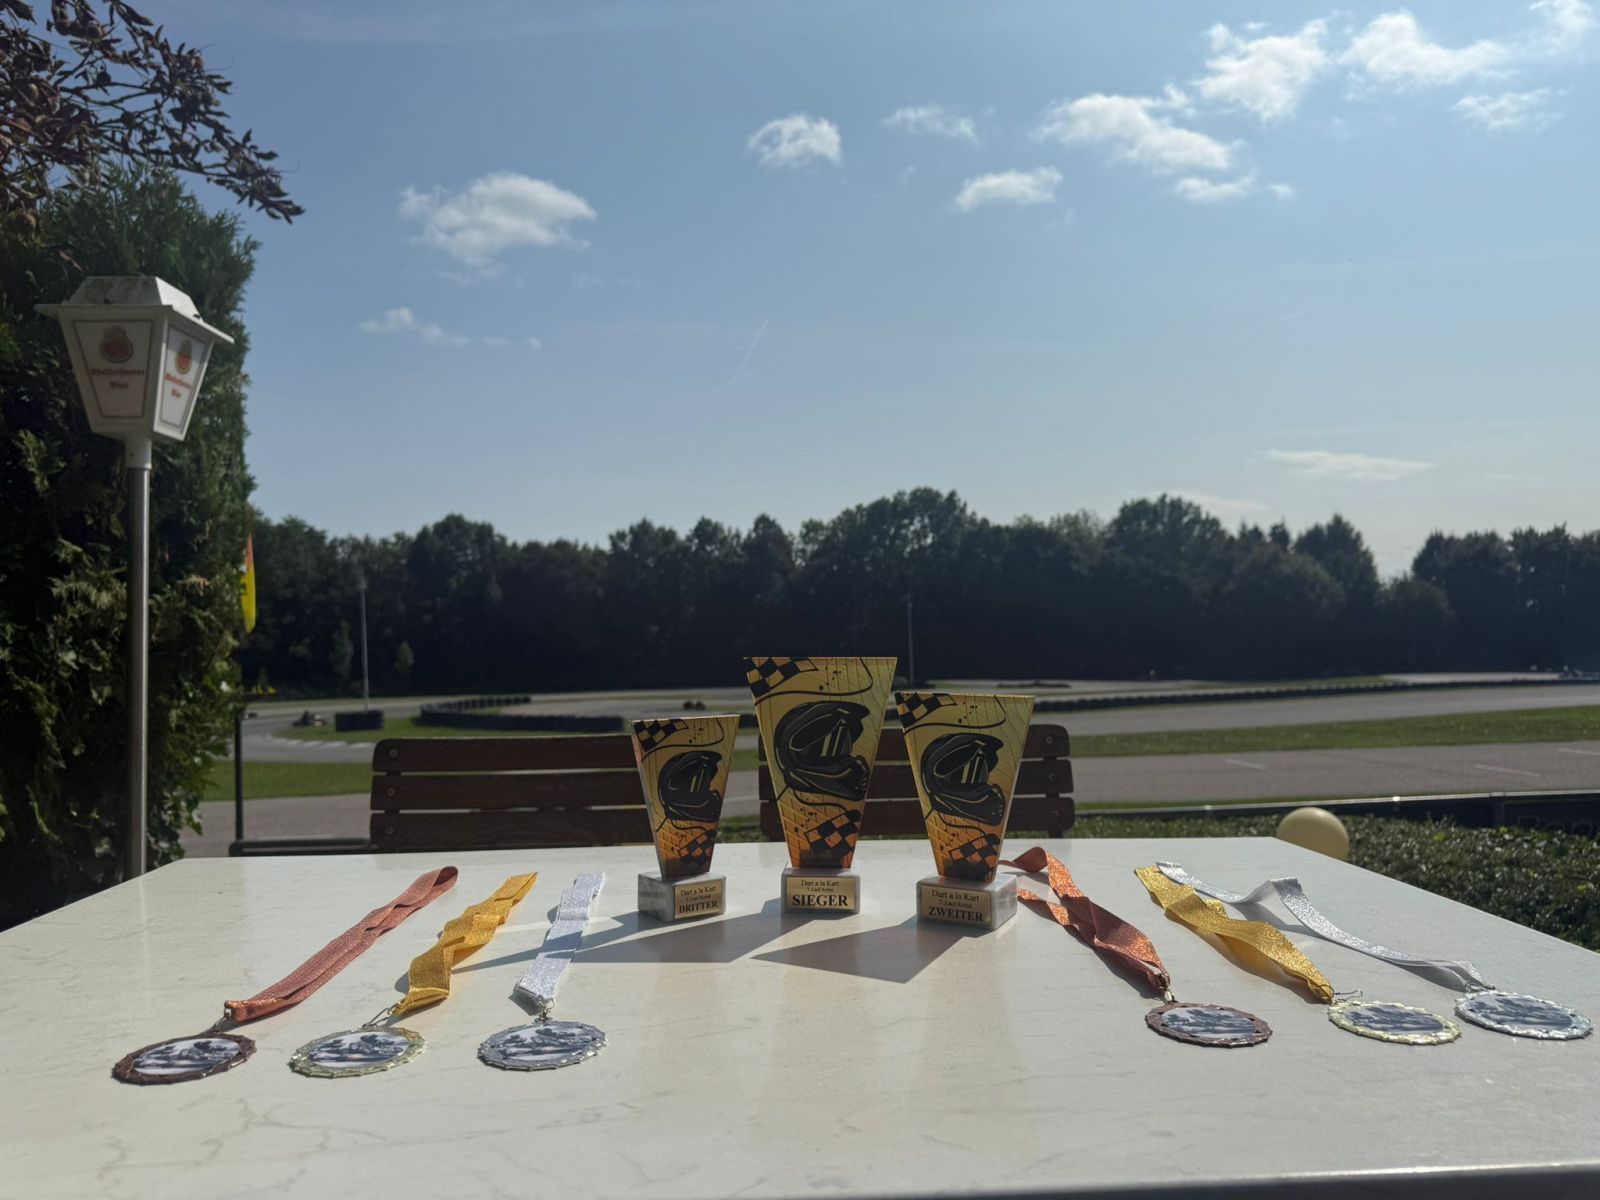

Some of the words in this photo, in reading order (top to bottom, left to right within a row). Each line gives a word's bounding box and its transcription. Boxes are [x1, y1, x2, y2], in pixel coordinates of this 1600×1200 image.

[792, 894, 849, 907] SIEGER
[931, 889, 947, 898] Dart
[964, 893, 980, 902] Kart
[679, 900, 718, 914] DRITTER
[928, 906, 984, 921] ZWEITER
